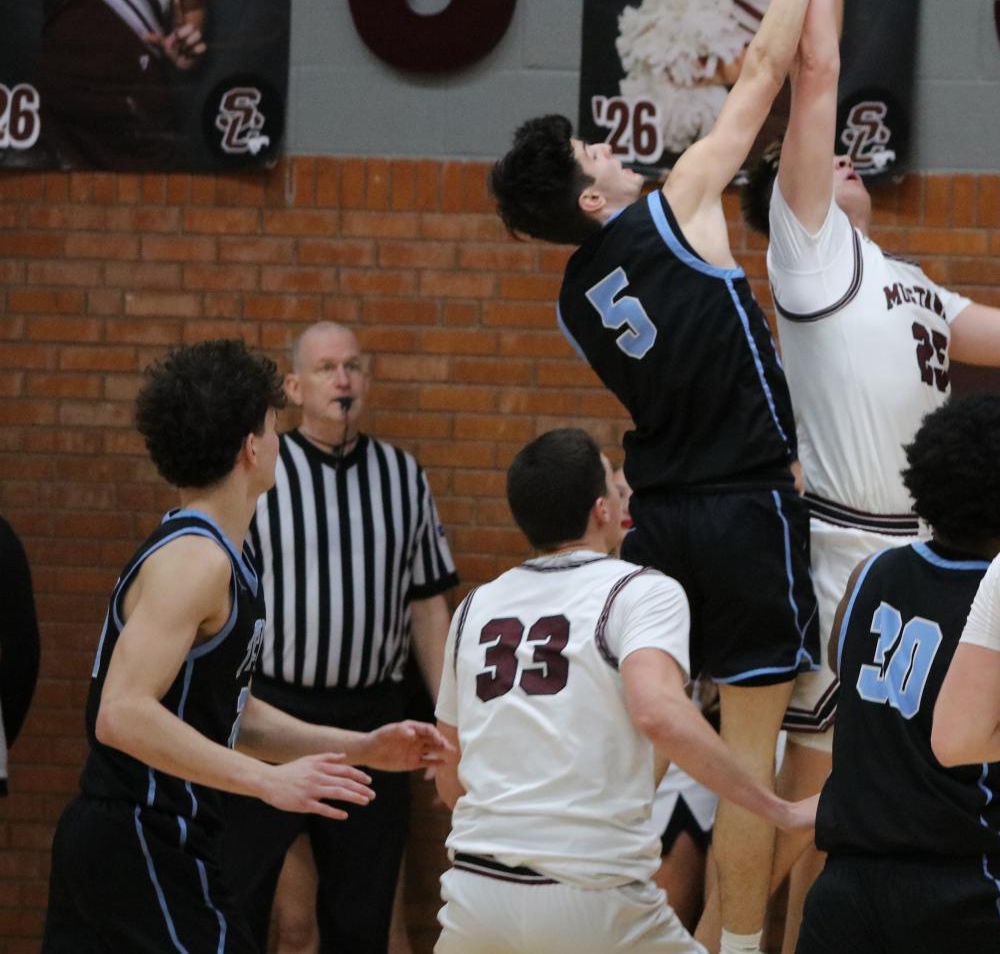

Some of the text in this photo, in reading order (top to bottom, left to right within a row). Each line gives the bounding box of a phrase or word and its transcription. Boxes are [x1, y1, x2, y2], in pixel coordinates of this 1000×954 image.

[586, 266, 658, 360] 5
[474, 614, 571, 703] 33
[856, 600, 942, 720] 30
